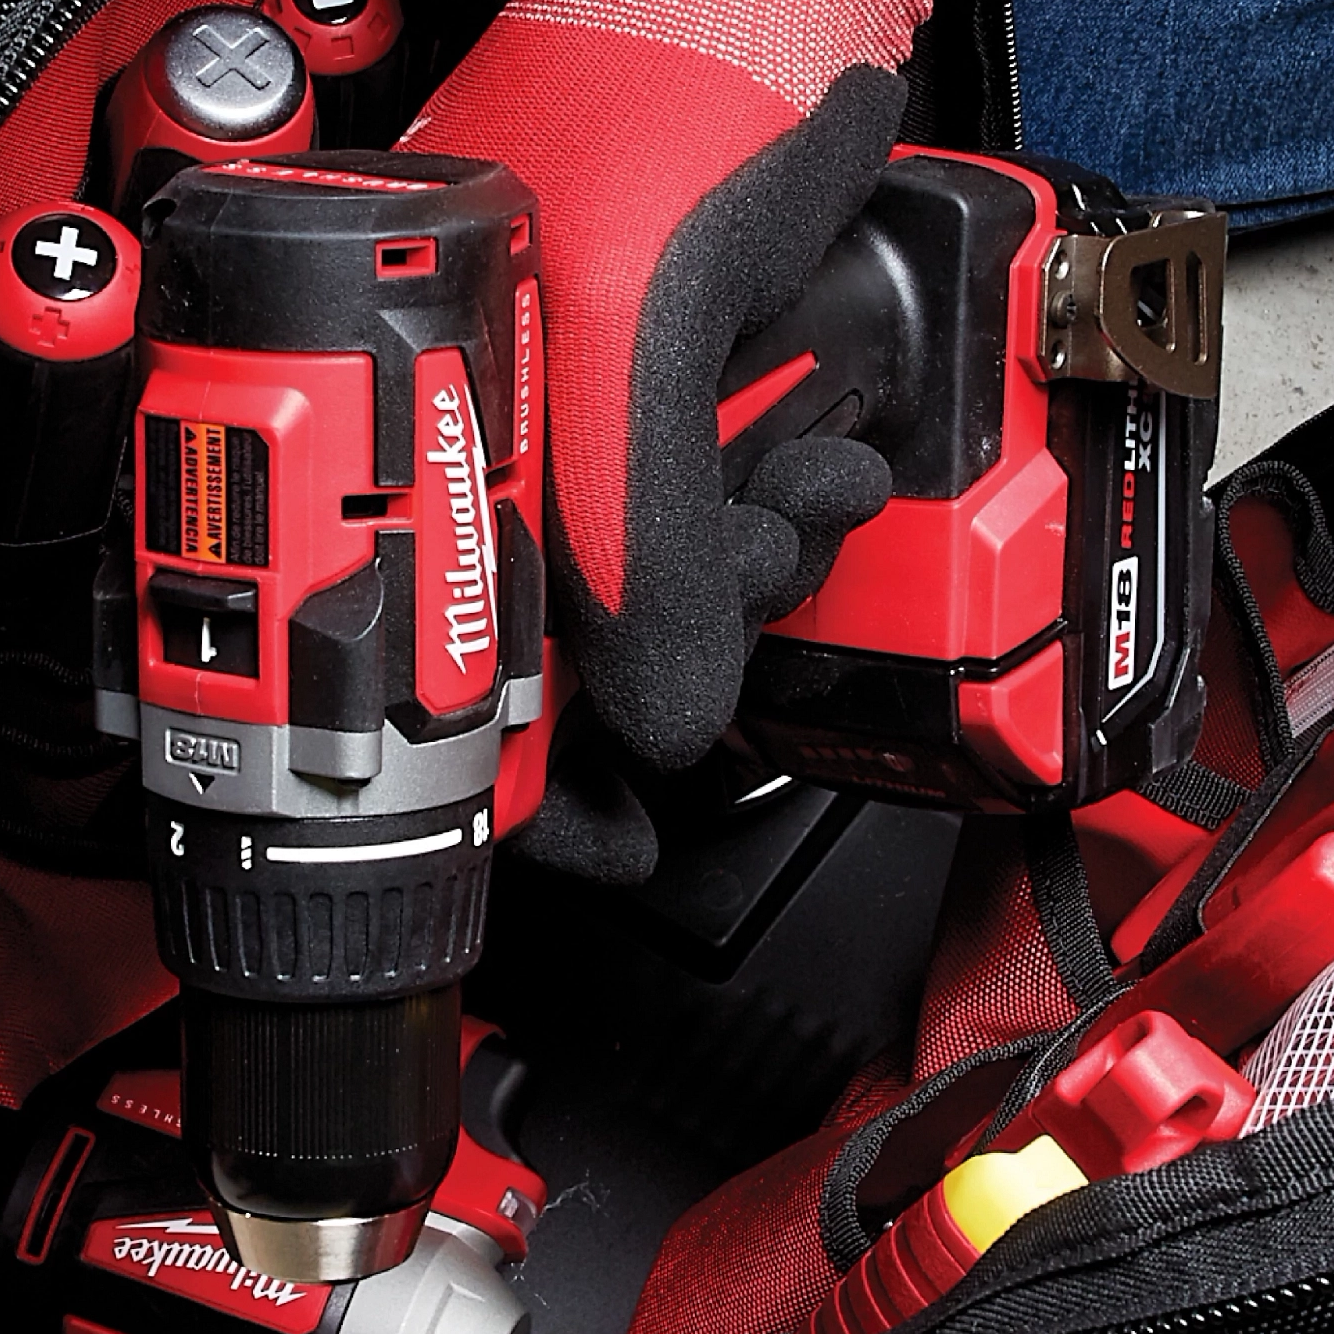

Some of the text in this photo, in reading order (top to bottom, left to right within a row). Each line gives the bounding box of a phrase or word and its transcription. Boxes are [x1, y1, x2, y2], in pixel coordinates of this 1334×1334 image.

[519, 293, 531, 455] BRUSHLESS
[1138, 411, 1153, 473] XC
[185, 446, 199, 553] ADVERTENCIA
[205, 428, 222, 541] AVERTISSEMENT
[426, 382, 491, 675] Milwaukee
[201, 617, 218, 663] 1
[1113, 568, 1132, 679] M18
[170, 733, 240, 771] M18
[170, 820, 185, 857] 2
[472, 807, 490, 847] 18
